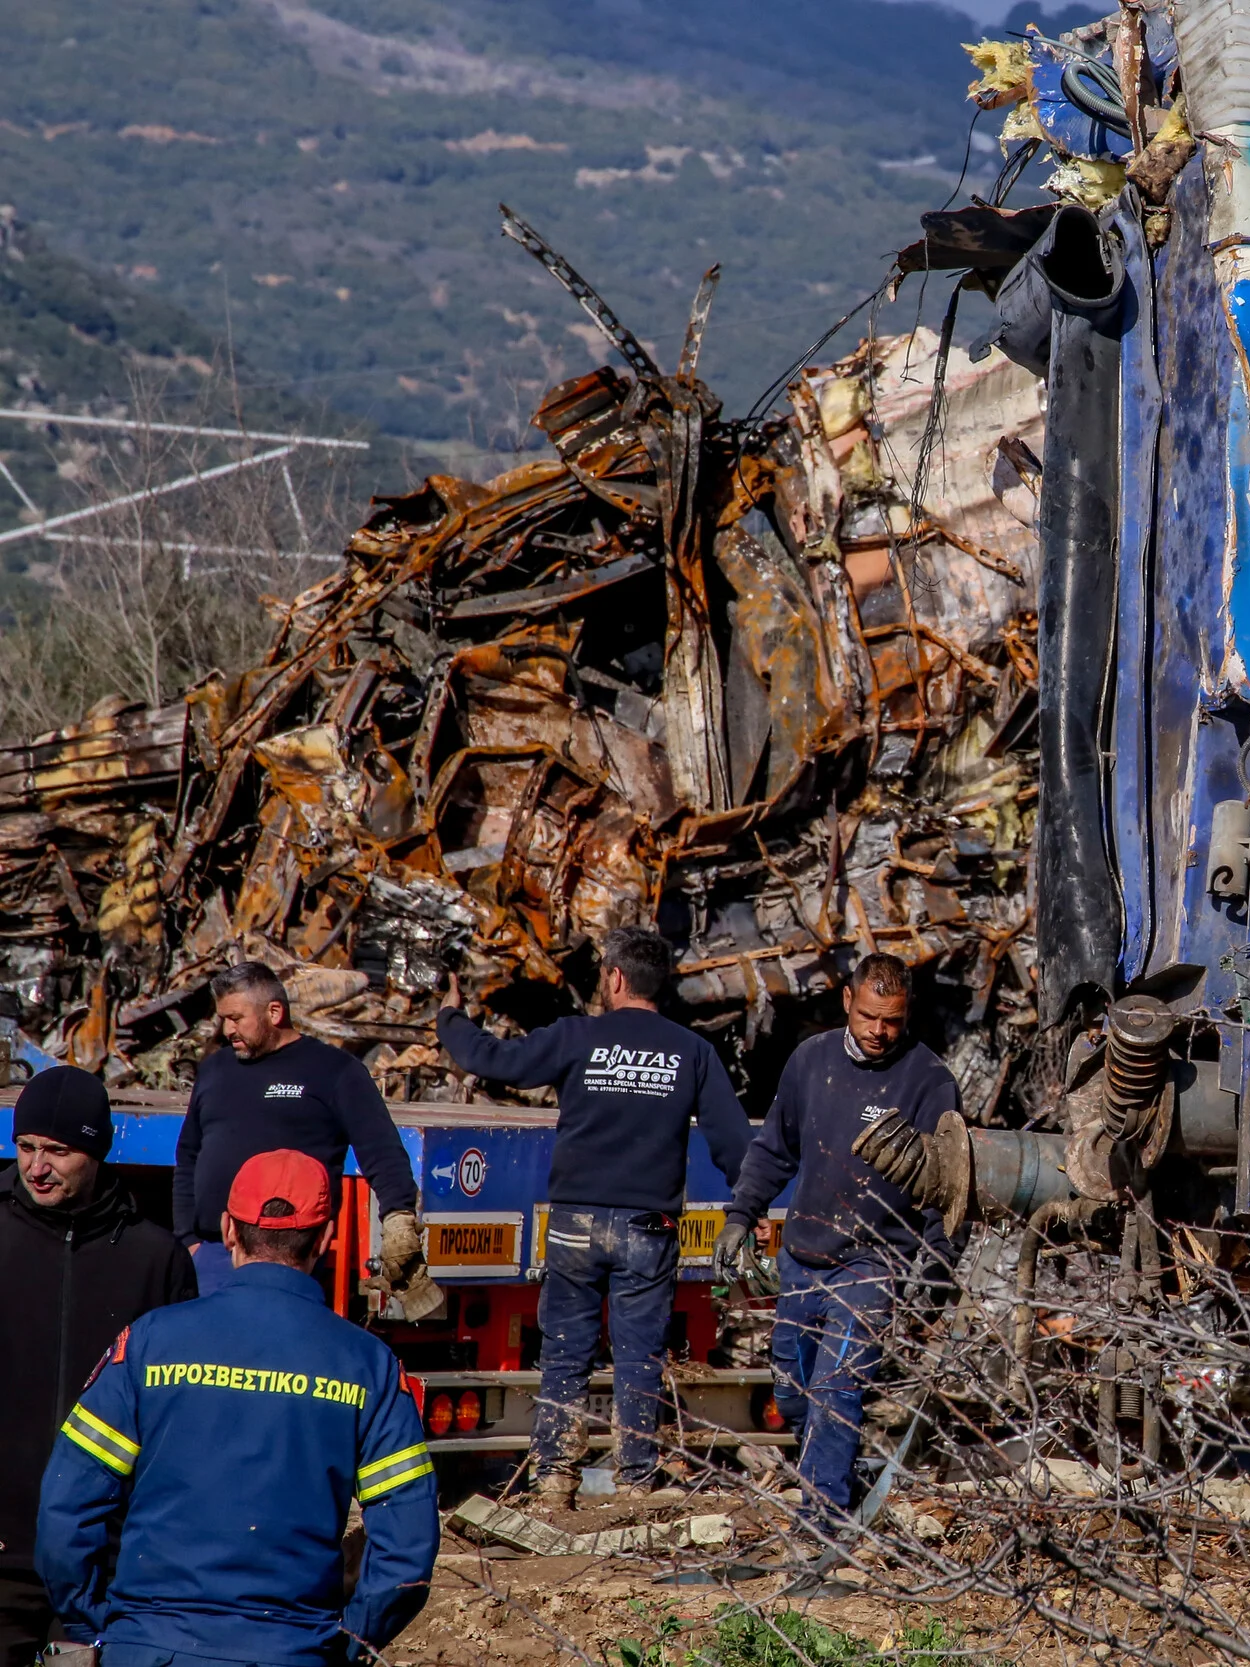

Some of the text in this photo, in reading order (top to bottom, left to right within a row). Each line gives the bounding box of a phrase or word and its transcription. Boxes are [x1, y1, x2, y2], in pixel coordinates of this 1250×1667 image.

[590, 1045, 682, 1069] BINTAS
[613, 1080, 637, 1088] SPECIAL
[638, 1081, 674, 1092] TRANSPORTS
[465, 1160, 480, 1184] 70
[440, 1228, 491, 1255] ΠΡΟΣΟΧΗ
[145, 1363, 308, 1395] ΠΥΡΟΣΒΕΣΤΙΚΟ
